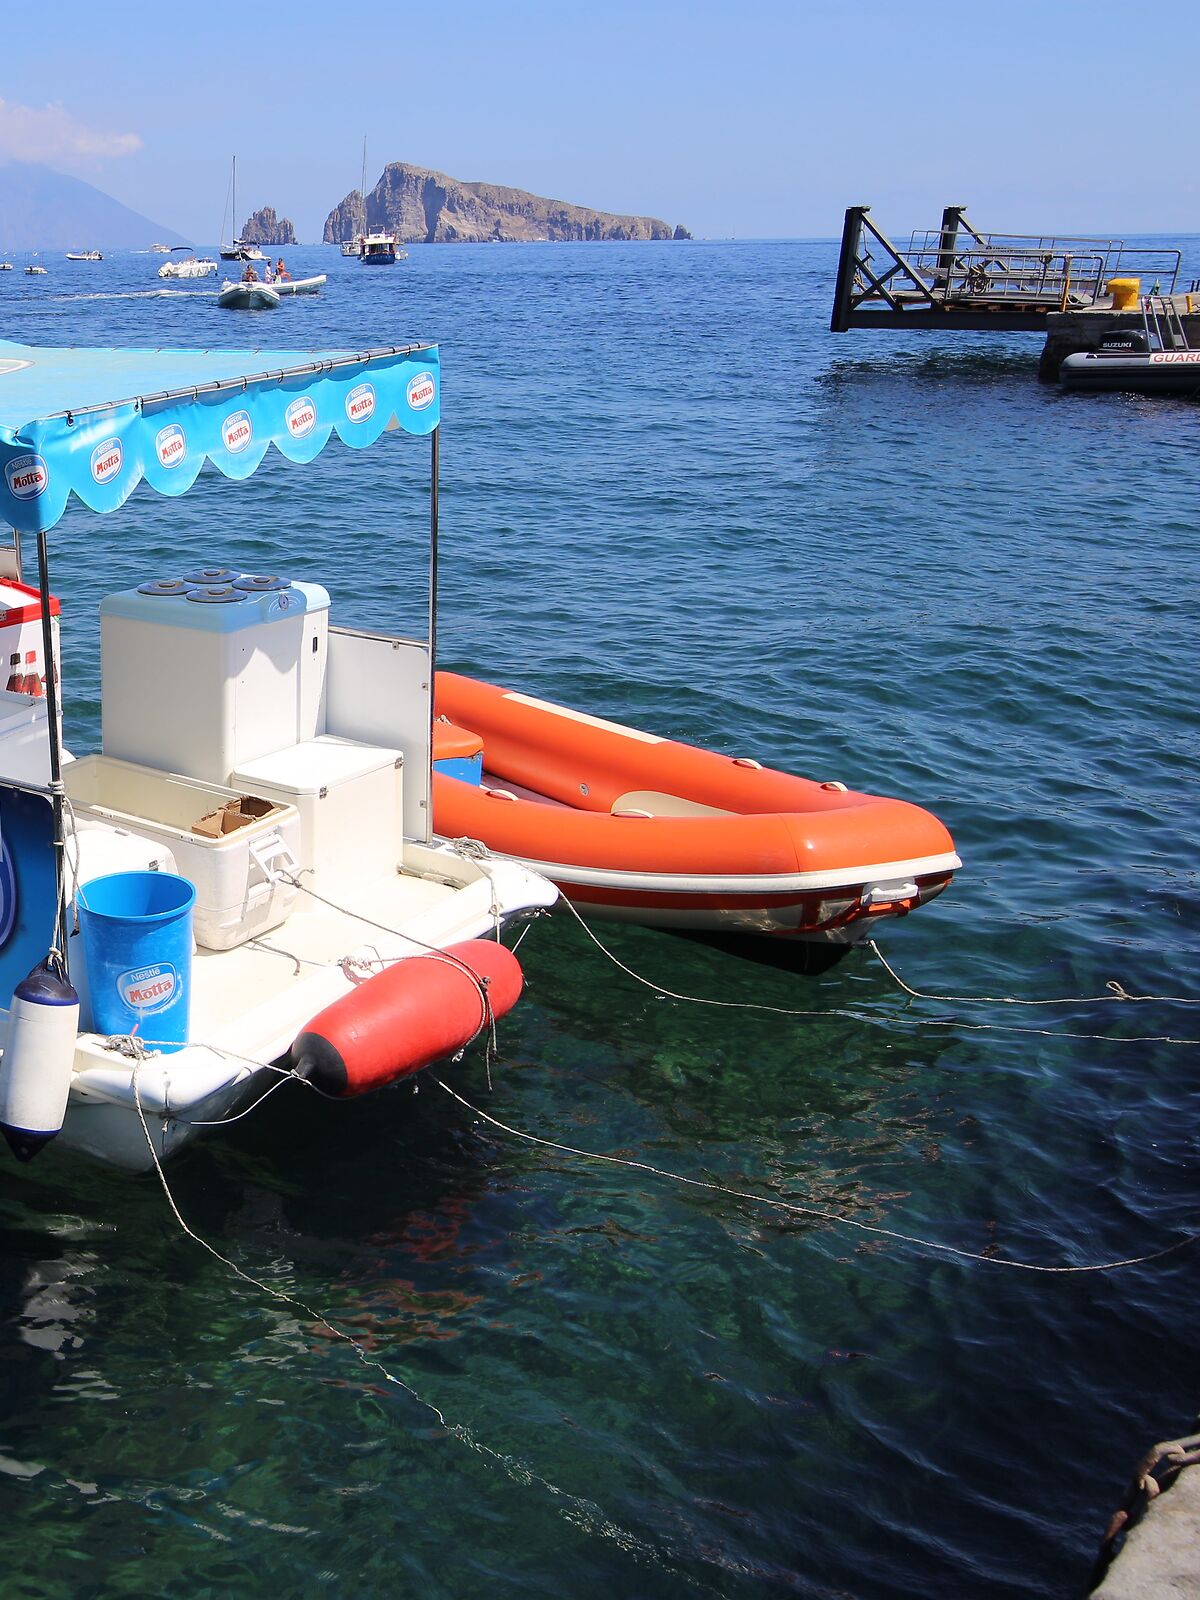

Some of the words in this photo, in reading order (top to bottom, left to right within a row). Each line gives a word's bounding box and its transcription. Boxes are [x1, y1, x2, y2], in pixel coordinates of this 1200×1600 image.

[411, 385, 433, 403] Motta
[350, 398, 373, 416] Motta
[291, 411, 313, 430] Motta
[227, 425, 249, 445] Motta
[161, 439, 183, 460] Motta
[96, 454, 119, 475] Motta
[13, 472, 45, 489] Motta
[129, 980, 173, 1003] Motta
